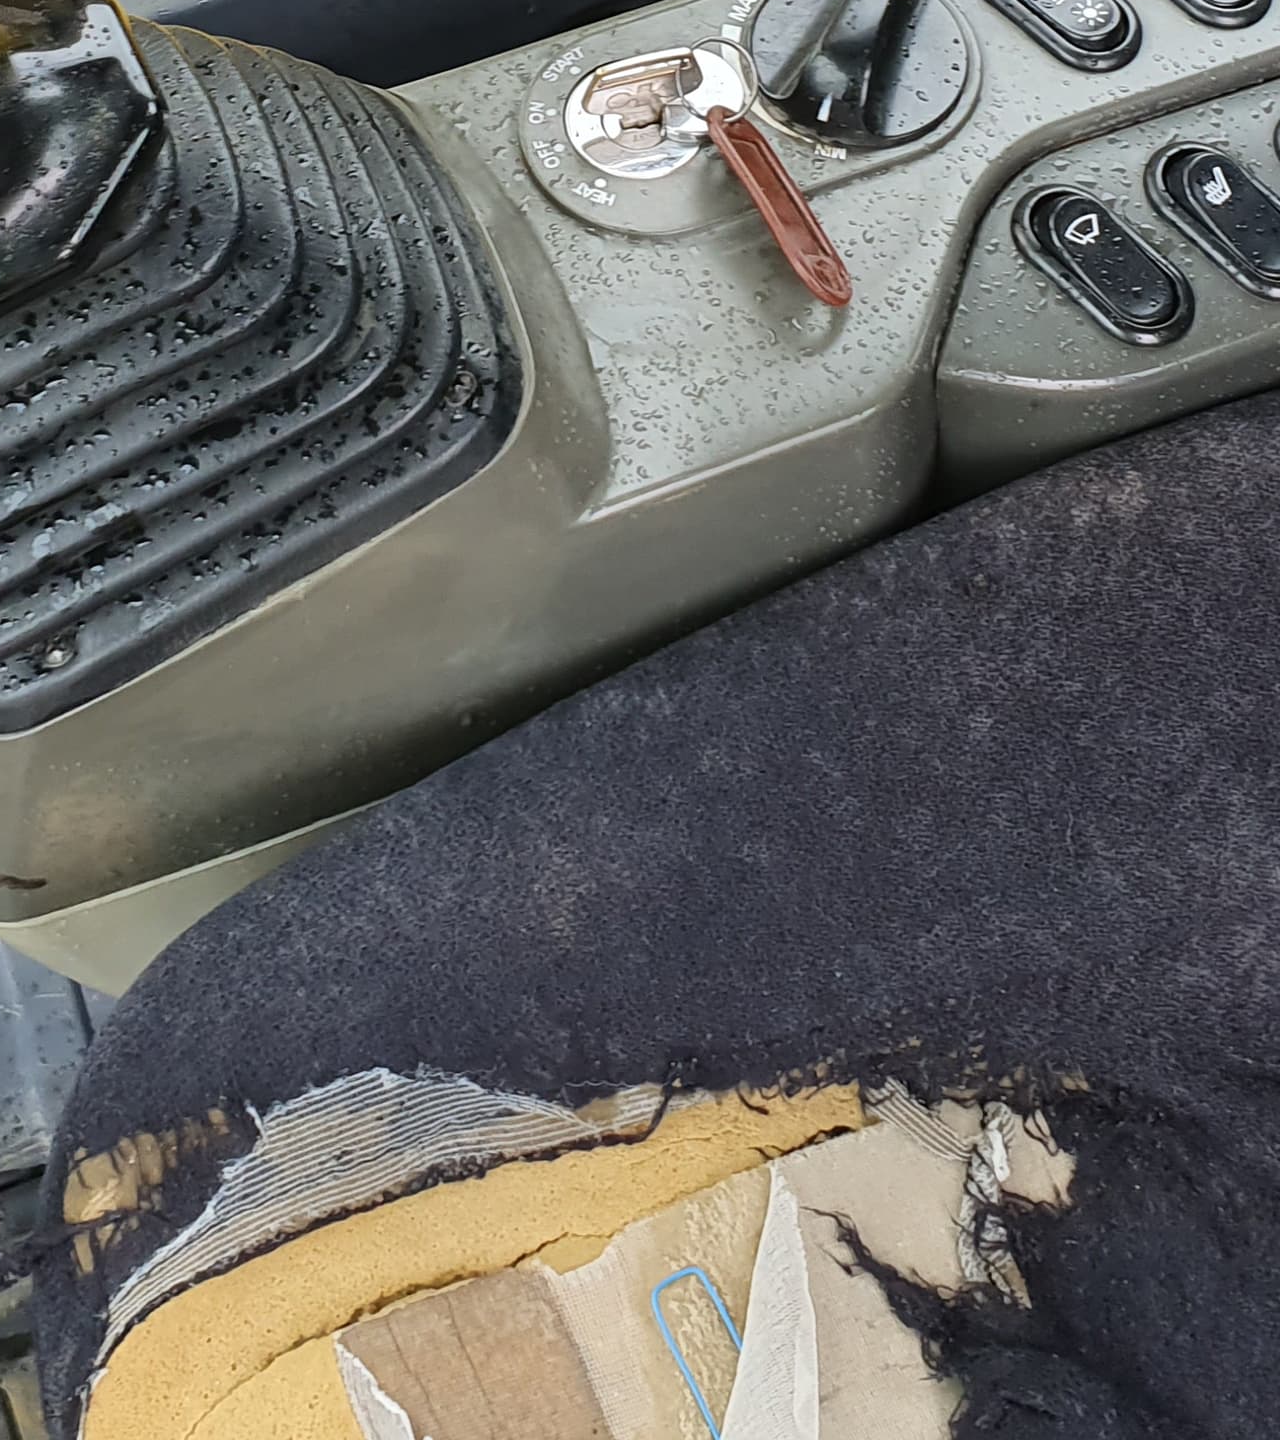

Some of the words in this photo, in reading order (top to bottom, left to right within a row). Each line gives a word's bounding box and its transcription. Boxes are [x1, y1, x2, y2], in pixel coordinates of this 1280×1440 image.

[542, 46, 585, 82] START
[528, 101, 545, 124] ON
[532, 139, 561, 169] OFF
[571, 181, 616, 207] HEAT
